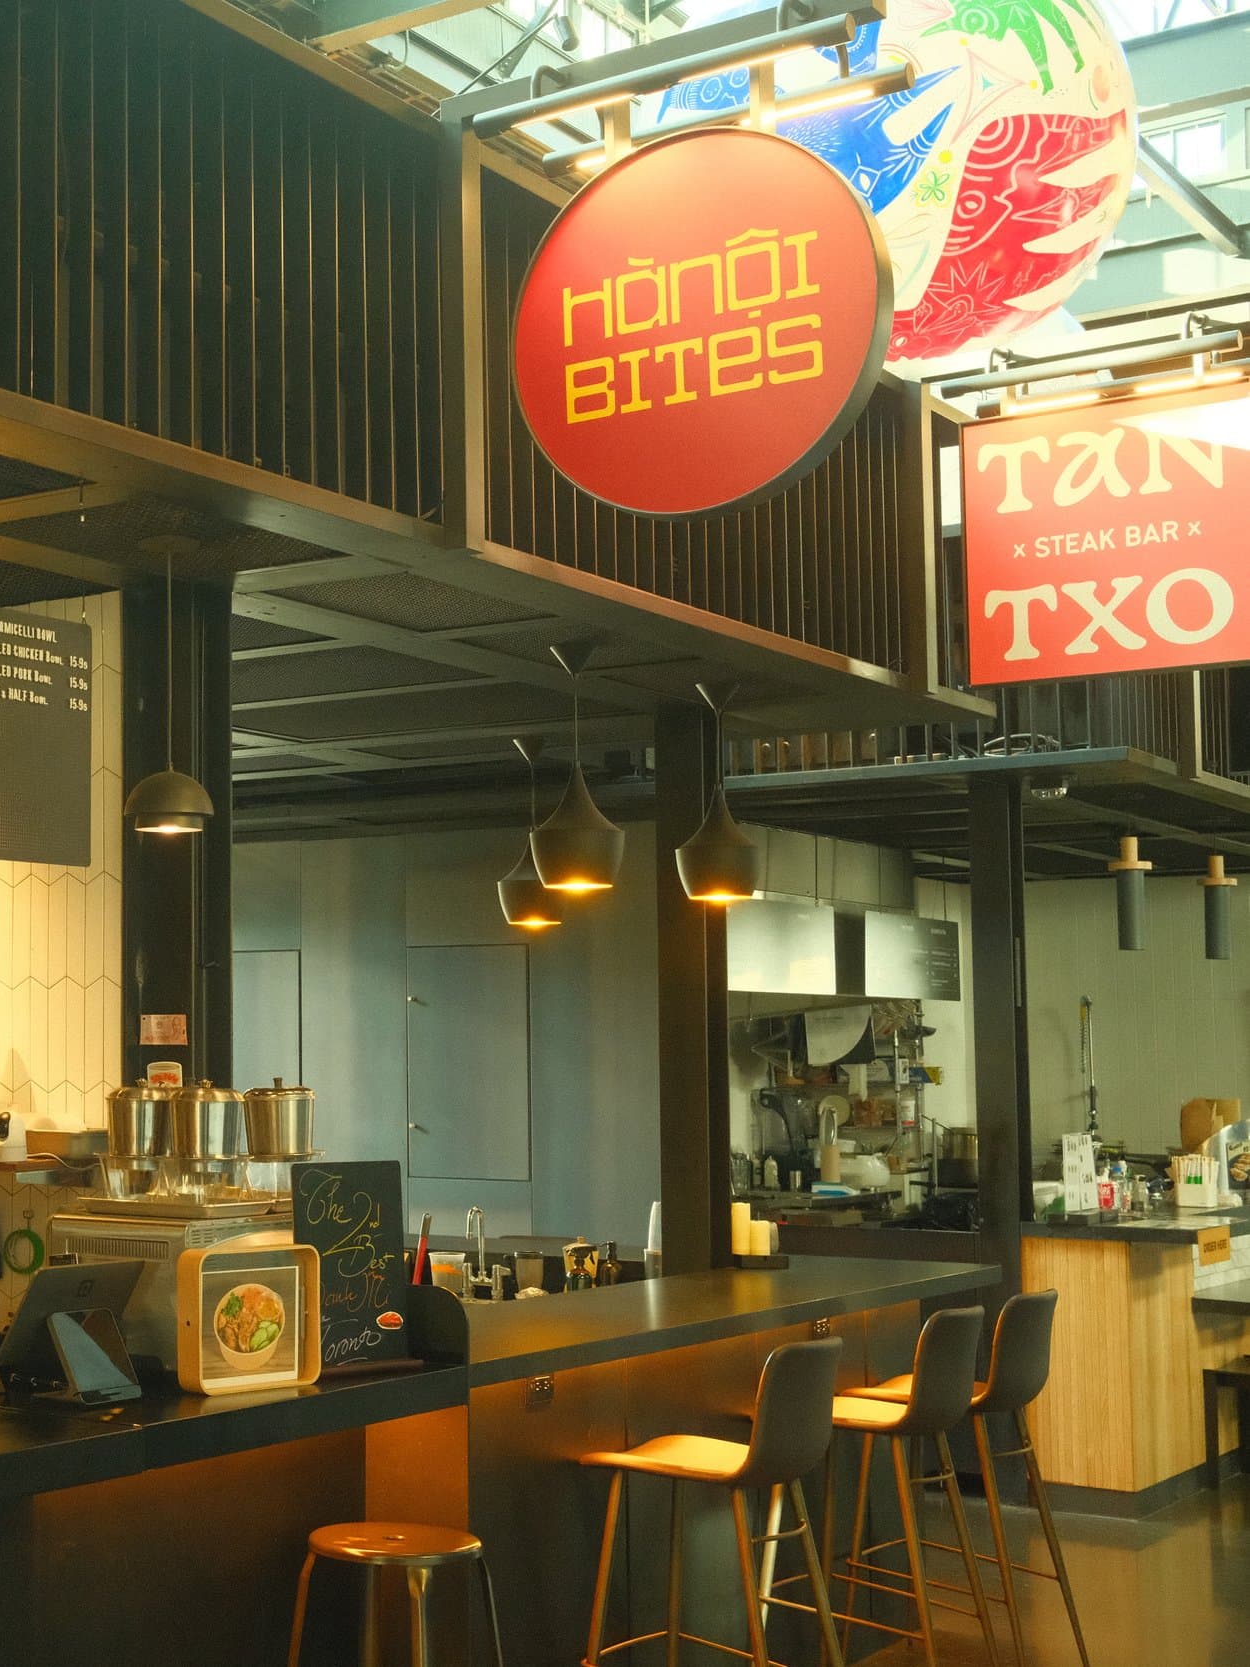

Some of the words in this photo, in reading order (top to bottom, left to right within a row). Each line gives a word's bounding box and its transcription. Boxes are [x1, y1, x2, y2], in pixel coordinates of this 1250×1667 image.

[1034, 527, 1116, 558] STEAK
[1125, 520, 1179, 547] BAR
[984, 568, 1234, 661] TXO
[36, 627, 58, 643] BOWL
[13, 645, 44, 661] CHICKEN
[46, 650, 64, 666] BOWL
[13, 667, 32, 681] PORK
[34, 670, 53, 685] BOWL
[8, 687, 27, 702] HALF
[29, 691, 48, 705] BOWL
[300, 1169, 352, 1225] The
[338, 1234, 395, 1278] Best
